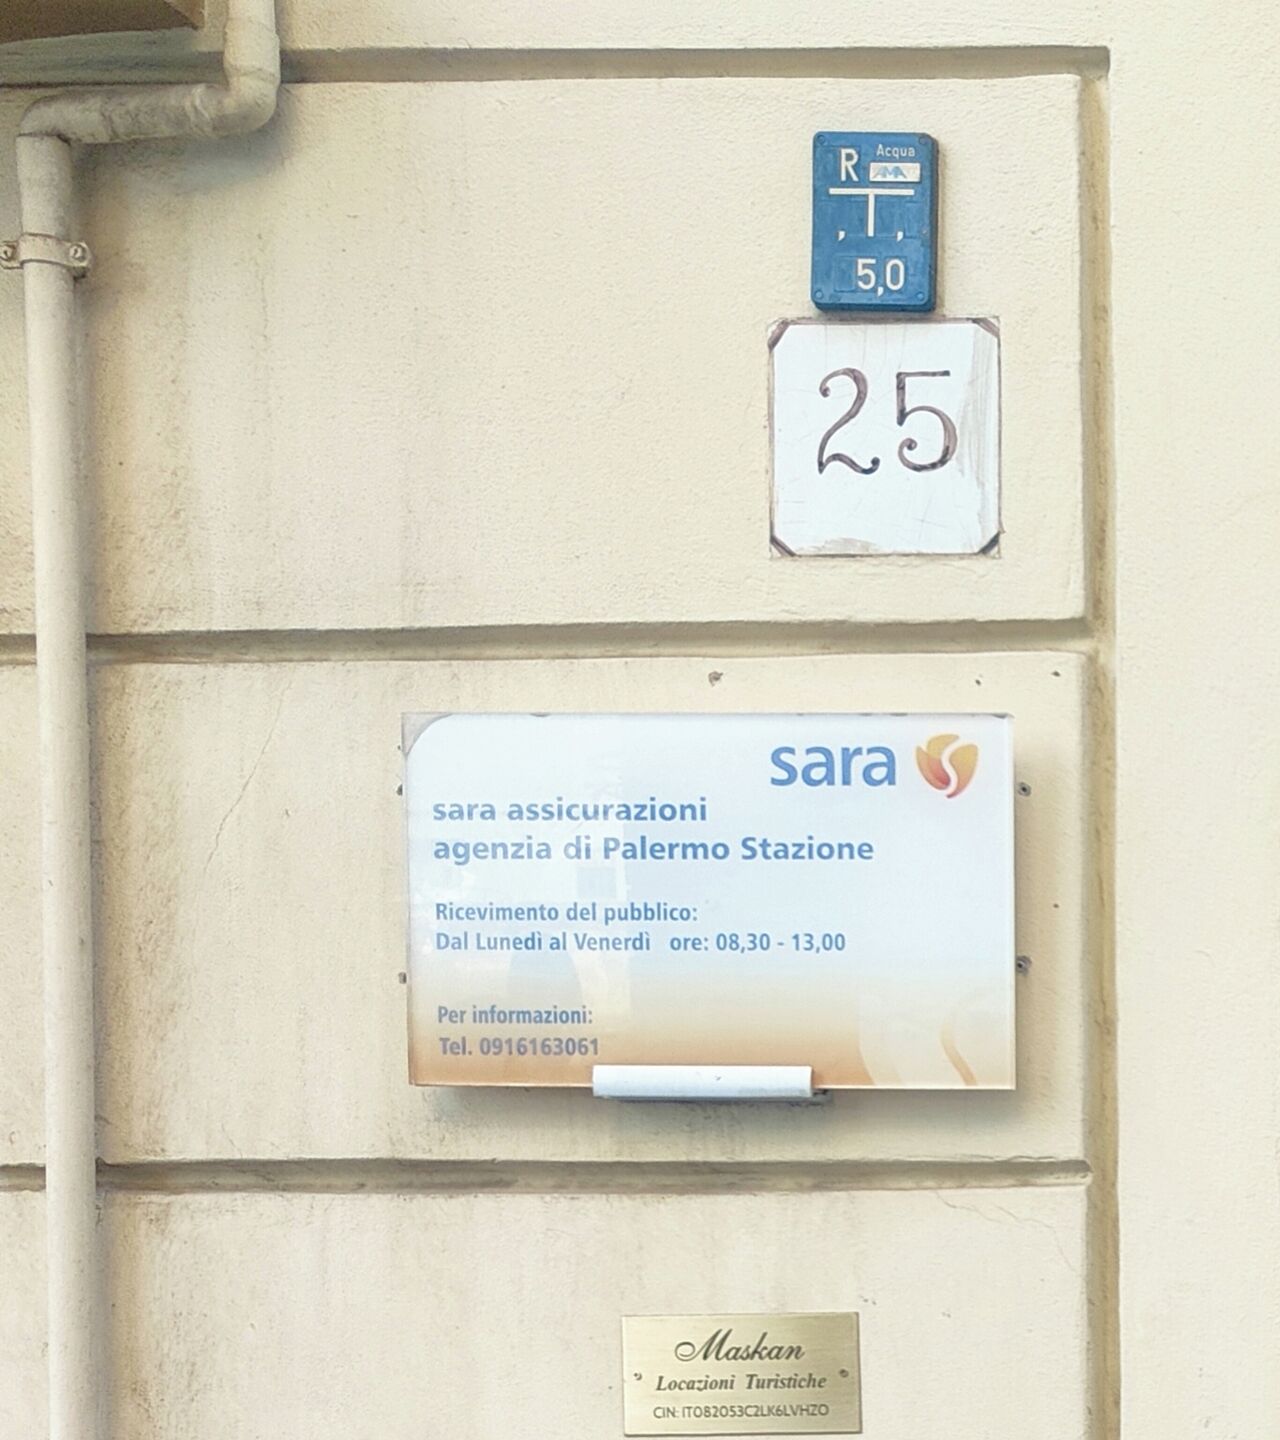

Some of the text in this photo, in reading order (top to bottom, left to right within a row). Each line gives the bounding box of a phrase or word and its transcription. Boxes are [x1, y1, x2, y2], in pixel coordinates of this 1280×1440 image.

[876, 143, 916, 160] Acqua
[840, 148, 859, 182] R
[856, 258, 905, 297] 5,0
[817, 367, 958, 474] 25
[771, 746, 896, 787] sara
[433, 797, 706, 821] sara assicurazioni
[433, 835, 874, 866] agenzia di Palermo Stazione
[435, 902, 697, 926] Ricevimento del pubblico:
[436, 931, 468, 950] Dal
[476, 931, 542, 950] Lunedì
[549, 932, 566, 950] al
[573, 932, 650, 951] Venerdì
[670, 937, 708, 951] ore:
[716, 933, 770, 953] 08,30
[792, 933, 845, 953] 13,00
[438, 1005, 592, 1024] Per informazioni:
[439, 1036, 598, 1056] Tel. 0916163061
[674, 1329, 804, 1362] Maskan
[656, 1373, 827, 1392] Locazioni Turistiche
[653, 1406, 678, 1419] CIN:
